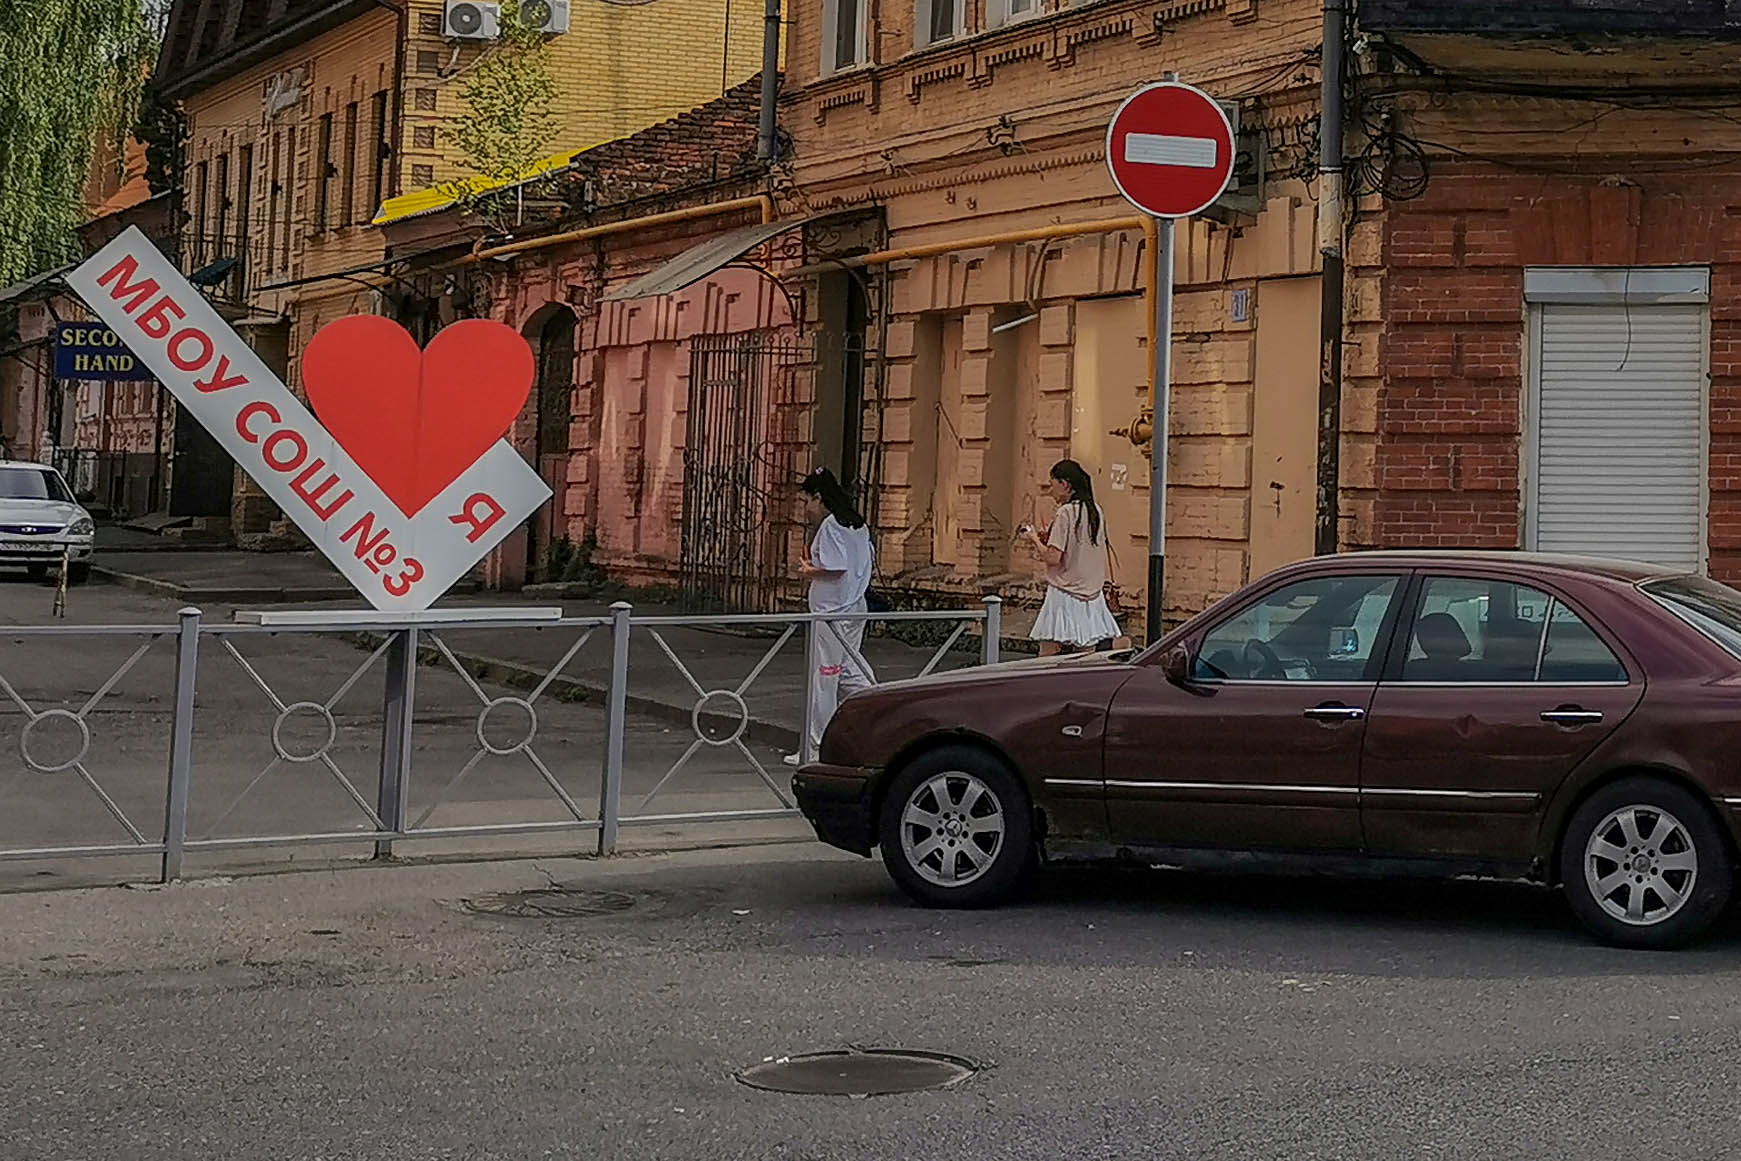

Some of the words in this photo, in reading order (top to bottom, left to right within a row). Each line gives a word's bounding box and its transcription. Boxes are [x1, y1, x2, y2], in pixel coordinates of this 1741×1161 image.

[61, 328, 124, 347] SECO
[74, 354, 134, 372] HAND
[97, 254, 249, 393] МБОУ
[236, 401, 354, 522] СОШ
[339, 511, 424, 597] №3
[448, 492, 506, 543] Я
